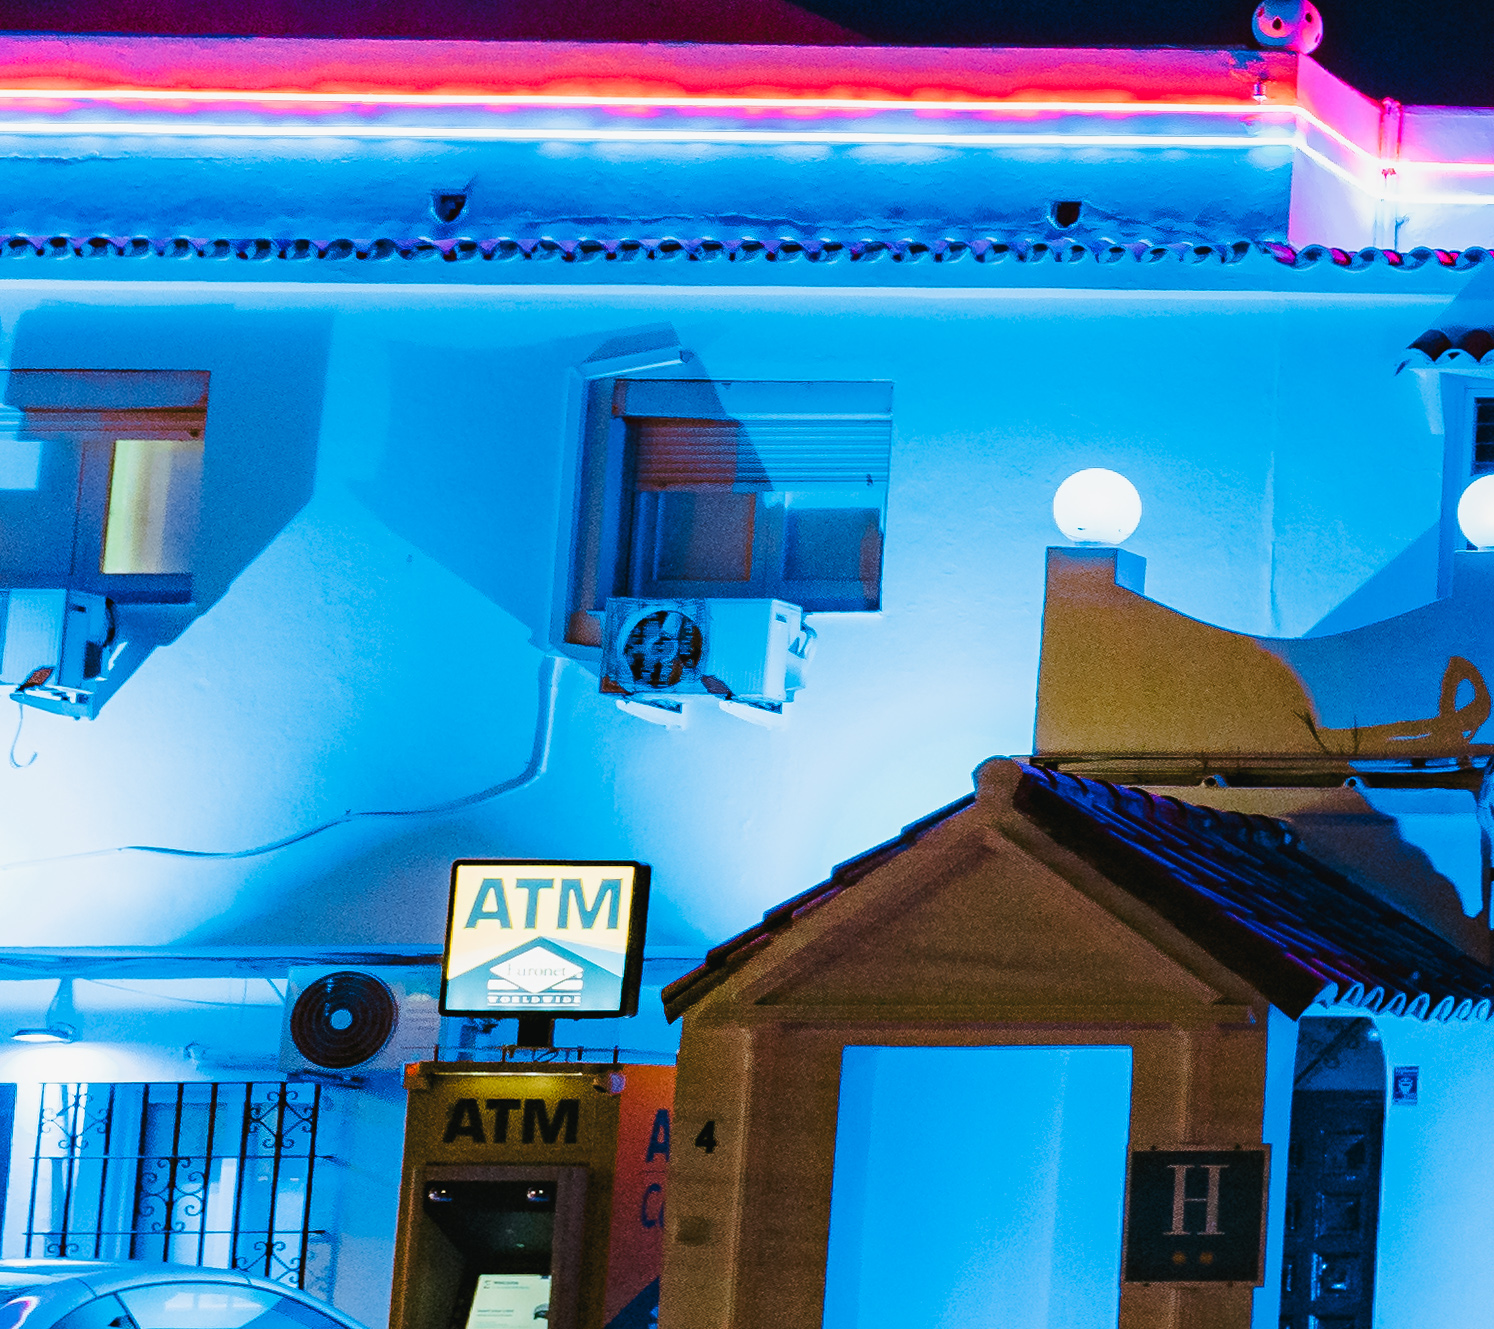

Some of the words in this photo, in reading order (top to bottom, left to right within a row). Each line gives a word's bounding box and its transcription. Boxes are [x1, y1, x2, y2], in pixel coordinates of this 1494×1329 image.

[463, 877, 624, 930] ATM
[443, 1098, 580, 1144] ATM
[695, 1120, 717, 1154] 4
[1163, 1164, 1230, 1236] H
